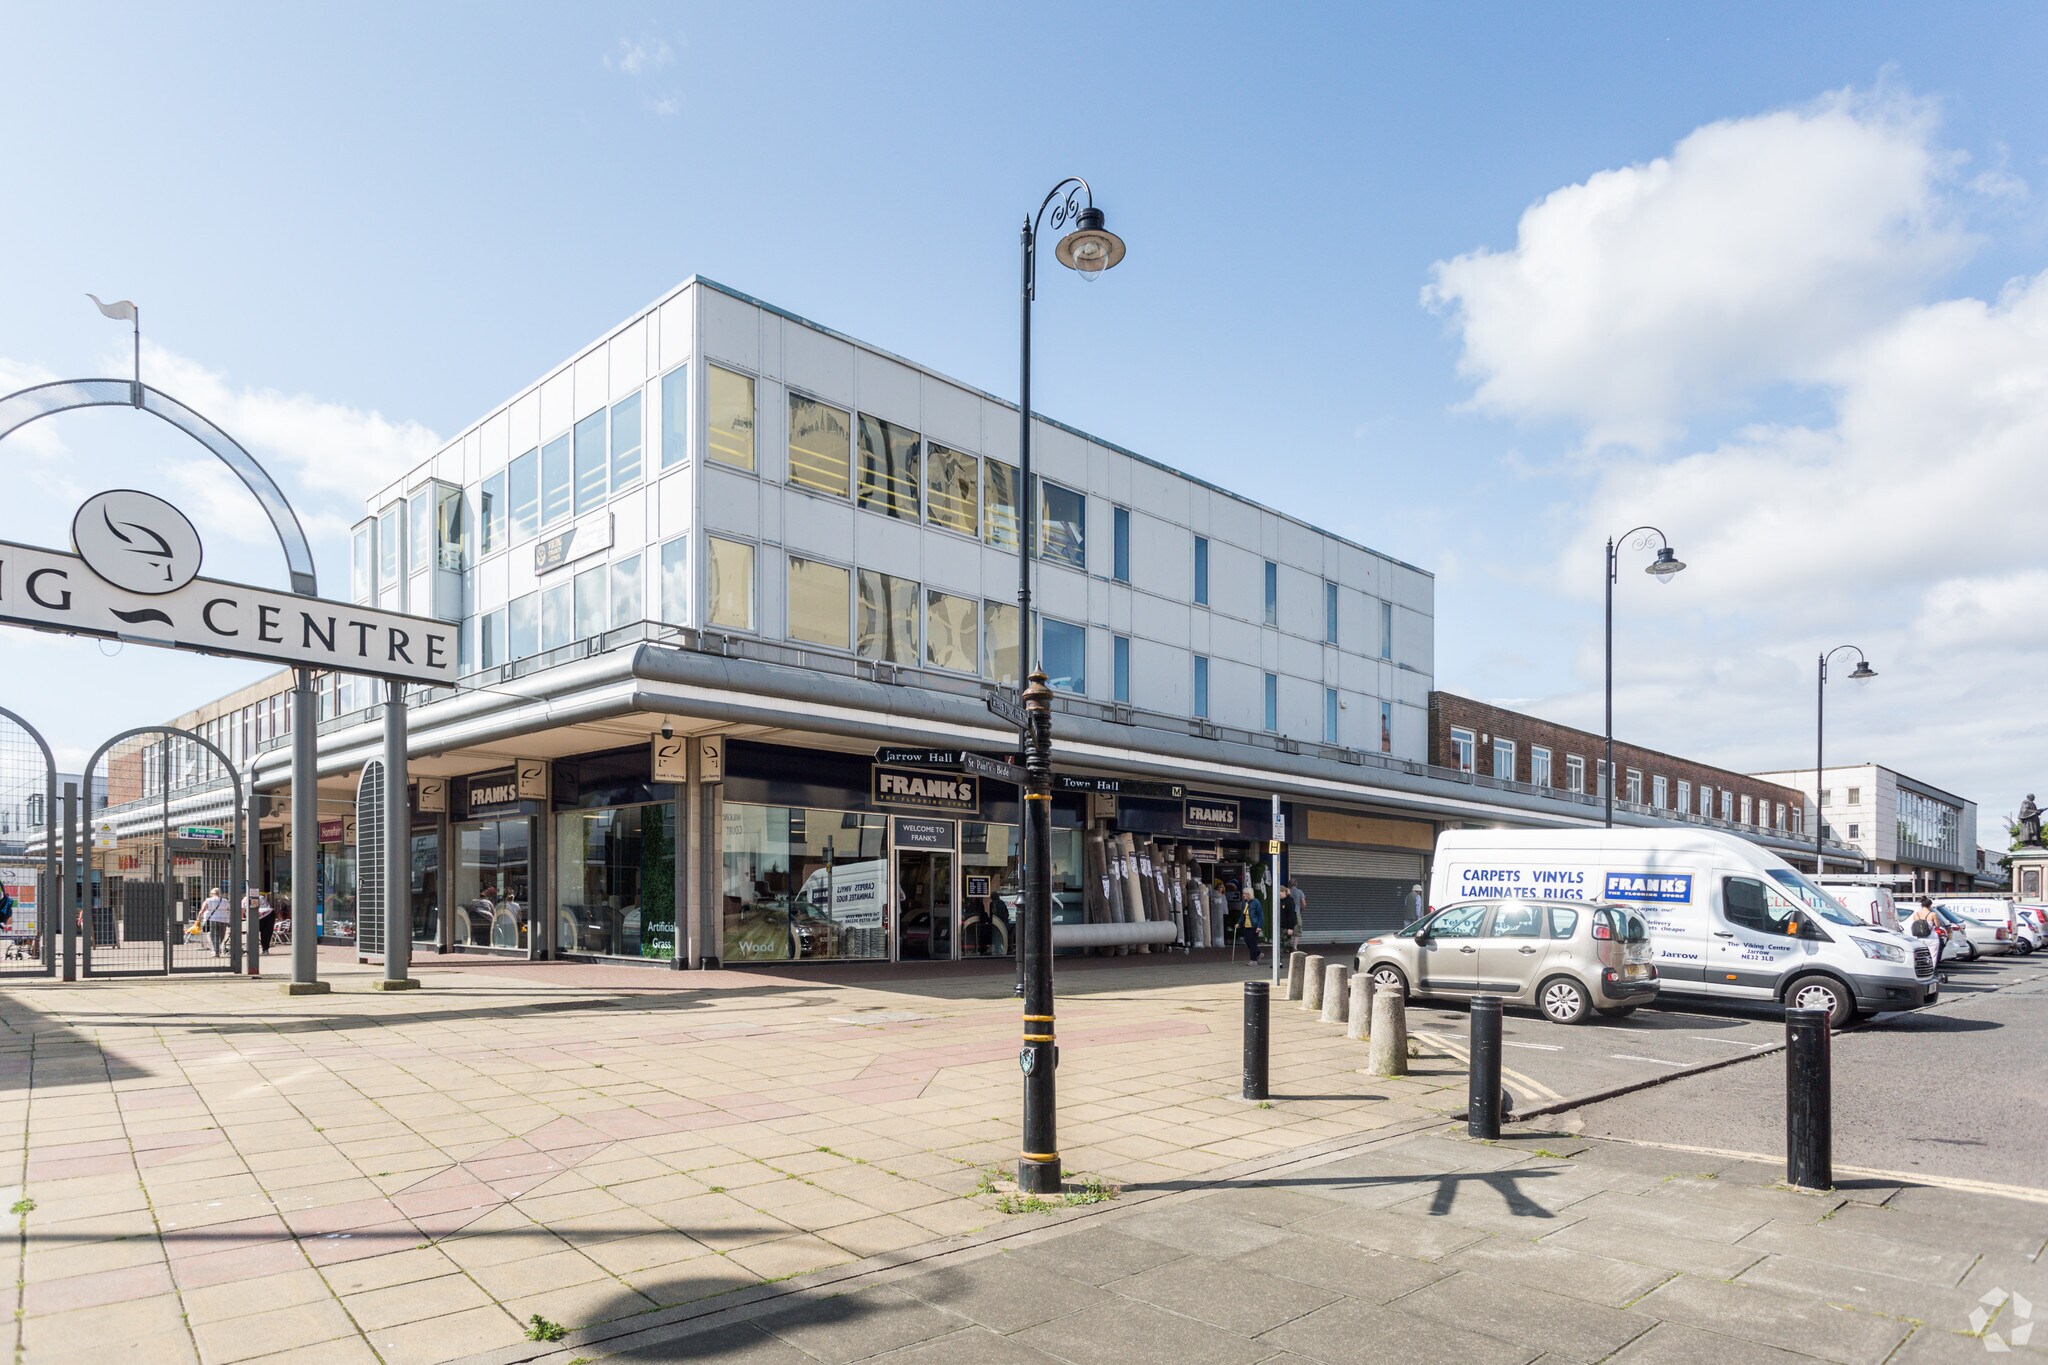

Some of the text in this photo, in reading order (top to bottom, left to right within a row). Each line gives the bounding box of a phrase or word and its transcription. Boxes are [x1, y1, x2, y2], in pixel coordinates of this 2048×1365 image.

[203, 598, 448, 669] CENTRE
[884, 750, 953, 763] Jarrow Hall
[967, 757, 975, 768] St
[996, 765, 1010, 777] Bede
[880, 774, 972, 801] FRANK'S
[1063, 777, 1119, 791] Town Hall
[1190, 805, 1234, 823] FRANK'S
[903, 824, 945, 834] WELCOME TO
[911, 834, 937, 842] FRANK'S
[1463, 869, 1584, 884] CARPETS VINYLS
[1608, 877, 1687, 893] FRANK'S
[1543, 888, 1584, 900] RUGS
[1962, 905, 1991, 914] Clean
[647, 920, 676, 932] Artificial
[652, 938, 672, 949] Grass
[739, 941, 774, 953] Wood
[1743, 942, 1765, 950] Viking
[1661, 950, 1699, 960] Jarrow
